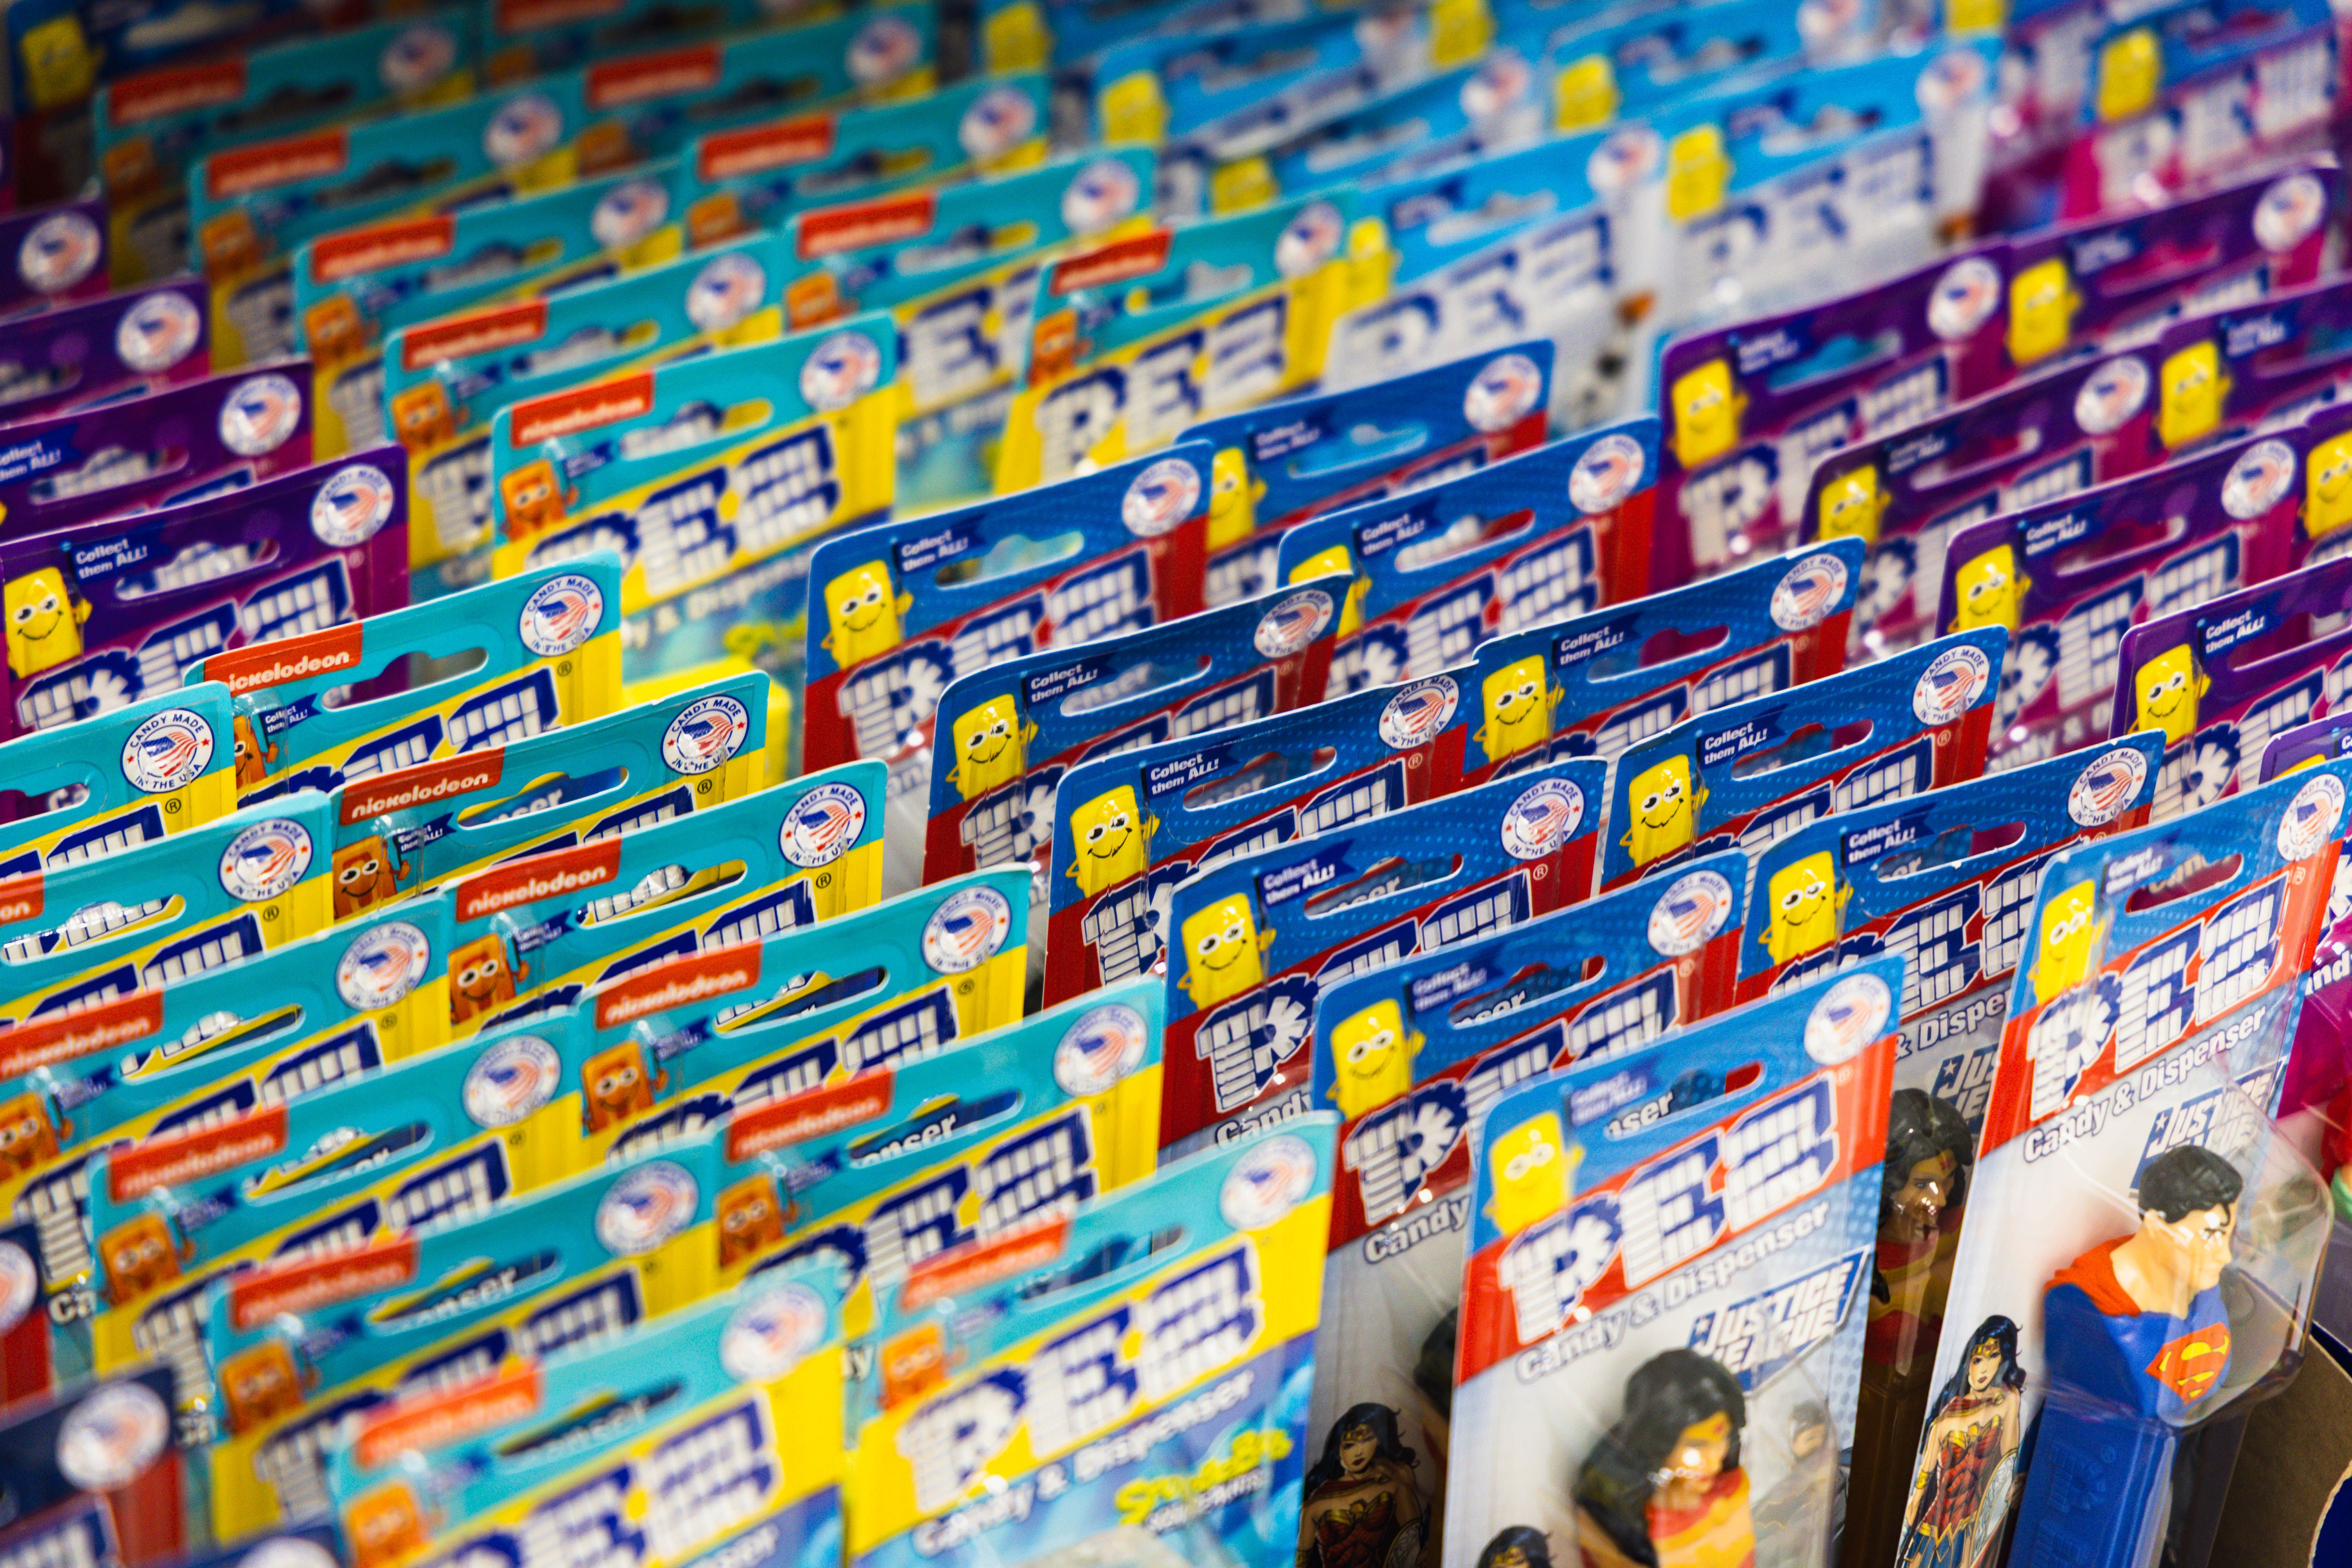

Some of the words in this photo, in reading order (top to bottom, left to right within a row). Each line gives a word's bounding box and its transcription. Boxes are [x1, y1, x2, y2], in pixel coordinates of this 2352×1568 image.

[1679, 353, 1949, 564] PEZ
[902, 529, 953, 558] Collect
[1361, 514, 1410, 541] Collect
[1363, 538, 1393, 554] them
[1396, 519, 1425, 540] ALL!
[76, 538, 129, 565] Collect
[79, 561, 113, 579] them
[116, 546, 148, 566] ALL!
[902, 553, 935, 572] them
[938, 536, 968, 559] ALL!
[1781, 558, 1815, 588] CANDY
[1819, 556, 1842, 575] MADE
[527, 579, 561, 612] CANDY
[566, 578, 595, 597] MADE
[1265, 593, 1301, 624] CANDY
[1305, 592, 1329, 606] MADE
[1324, 519, 1600, 704] PEZ
[1560, 626, 1610, 652] Collect
[2205, 634, 2234, 653] them
[2236, 615, 2265, 639] ALL!
[2206, 610, 2252, 640] Collect
[20, 557, 350, 732] PEZ
[1560, 647, 1591, 666] them
[1594, 632, 1624, 652] ALL!
[225, 651, 350, 691] ickelodeon
[1030, 664, 1082, 690] Collect
[1922, 651, 1957, 683] CANDY
[1961, 648, 1985, 668] MADE
[1031, 685, 1064, 703] them
[1067, 670, 1098, 688] ALL!
[1389, 680, 1425, 710] CANDY
[1430, 677, 1455, 698] MADE
[130, 716, 166, 749] CANDY
[173, 713, 204, 734] MADE
[671, 701, 708, 733] CANDY
[713, 699, 741, 717] MADE
[1930, 711, 1950, 722] THE
[1401, 734, 1421, 746] THE
[1704, 722, 1753, 751] Collect
[1704, 746, 1735, 765] them
[1737, 728, 1768, 751] ALL!
[135, 775, 145, 786] IN
[152, 779, 175, 789] THE
[1151, 754, 1203, 781] Collect
[1152, 777, 1185, 795] them
[1188, 759, 1219, 781] ALL!
[2080, 753, 2116, 783] CANDY
[2119, 751, 2142, 769] MADE
[352, 772, 488, 819] nickelodeon
[789, 791, 824, 823] CANDY
[829, 786, 858, 807] MADE
[1510, 783, 1546, 816] CANDY
[1552, 781, 1579, 800] MADE
[2325, 779, 2342, 800] MADE
[1510, 843, 1521, 855] IN
[1524, 846, 1545, 857] THE
[1849, 820, 1900, 849] Collect
[1849, 844, 1882, 863] them
[1884, 827, 1916, 849] ALL!
[466, 866, 606, 916] nickelodeon
[1263, 859, 1319, 890] Collect
[1266, 884, 1301, 905] them
[1303, 864, 1336, 889] ALL!
[2025, 871, 2290, 1122] PEZ
[1918, 989, 2011, 1051] Dispe
[1342, 964, 1681, 1227] PEZ
[2024, 1097, 2109, 1162] Candy
[2112, 1083, 2136, 1114] &
[2138, 1007, 2266, 1101] Dispenser
[1497, 1073, 1840, 1345] PEZ
[1363, 1194, 1470, 1264] Candy
[1516, 1307, 1626, 1383] Candy
[1629, 1295, 1659, 1328] &
[1665, 1200, 1829, 1310] Dispenser
[1693, 1260, 1855, 1357] JUSTICE
[1712, 1301, 1838, 1375] EAGUE
[895, 1243, 1265, 1514] PEZ
